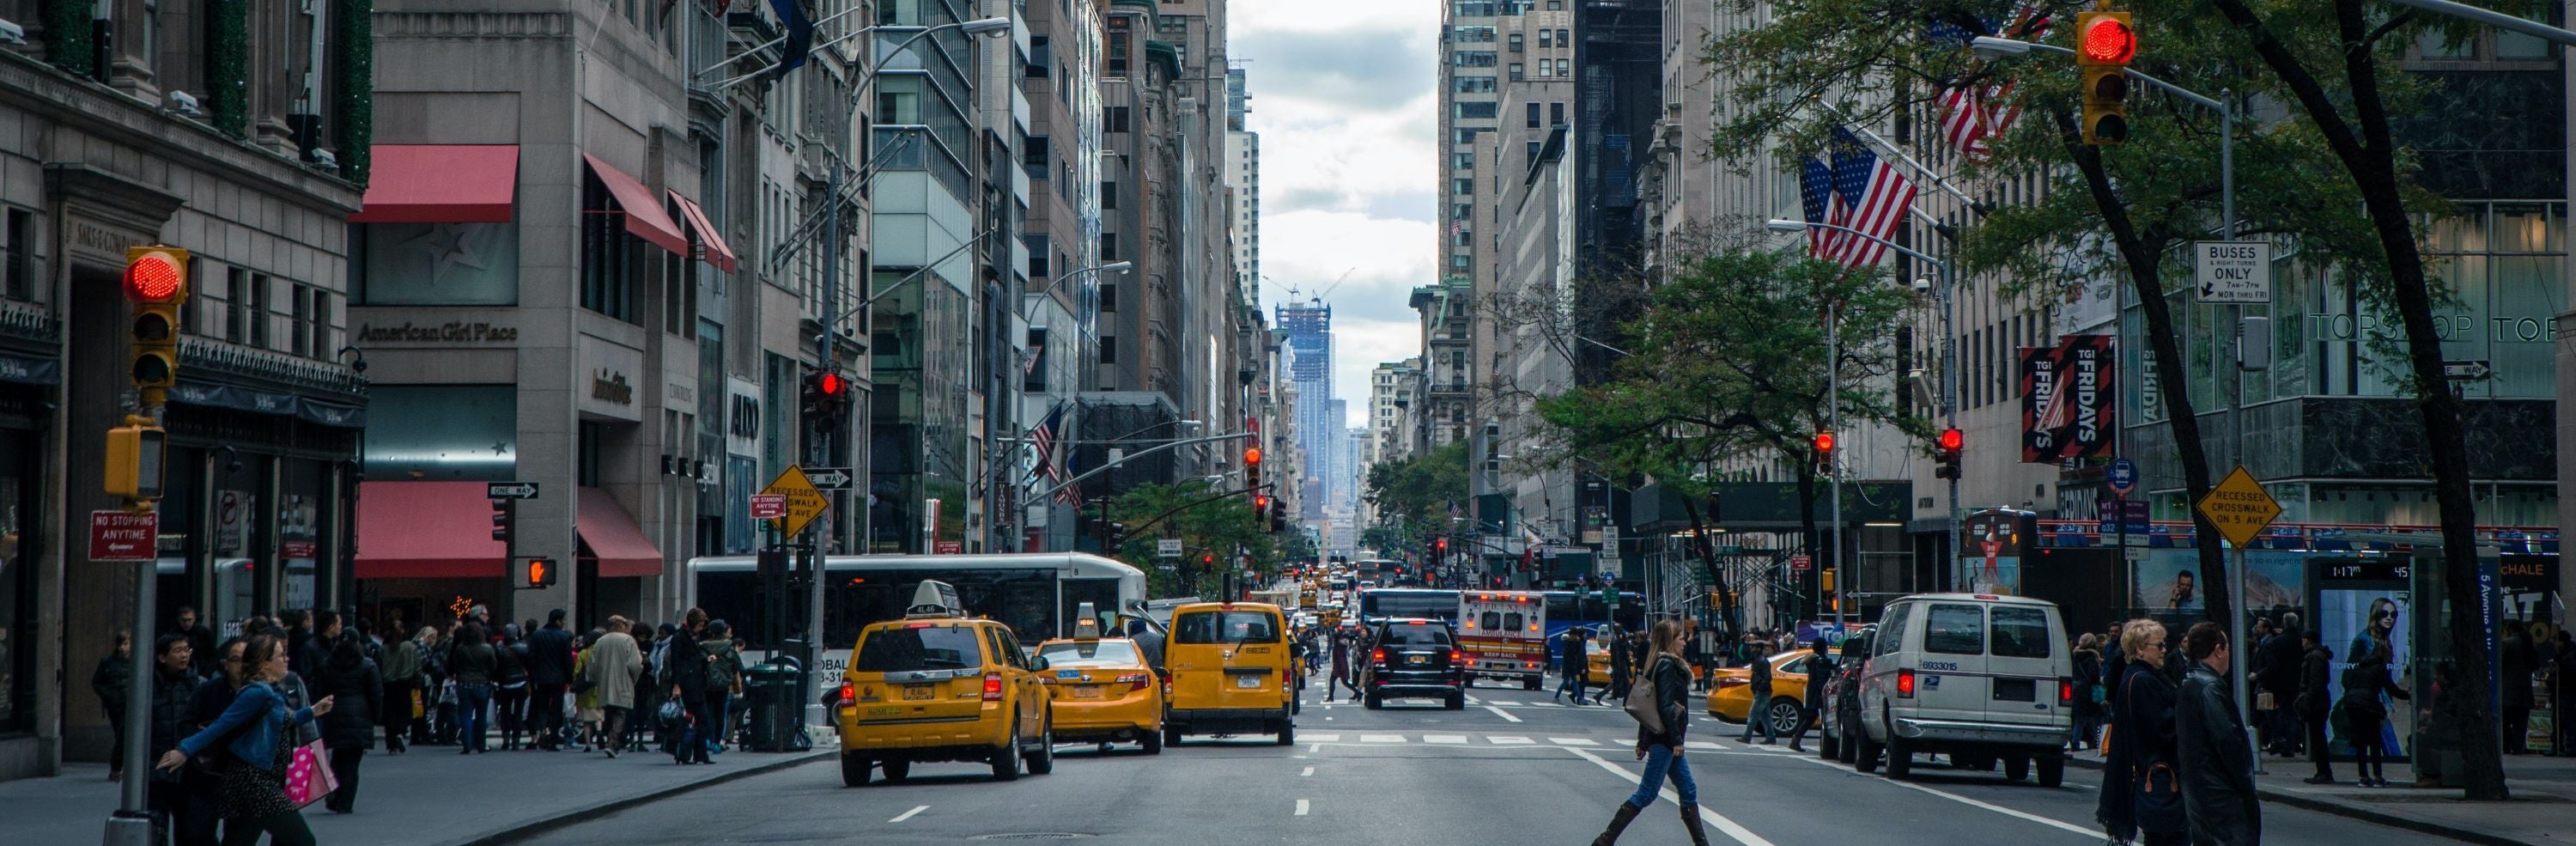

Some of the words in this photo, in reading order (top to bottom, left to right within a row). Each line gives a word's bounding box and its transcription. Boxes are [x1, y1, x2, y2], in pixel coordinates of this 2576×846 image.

[2210, 246, 2256, 259] BUSES
[2215, 268, 2251, 279] ONLY
[358, 322, 440, 342] American
[441, 321, 471, 342] Girl
[474, 322, 518, 342] Place
[2308, 313, 2473, 340] TOPSOP
[2078, 350, 2095, 359] TGI
[2035, 361, 2051, 370] TGI
[2464, 366, 2484, 375] WAY
[2078, 360, 2096, 442] FRIDAYS
[2035, 371, 2052, 448] FRIDYS
[730, 393, 759, 440] ALDO
[770, 487, 815, 496] RECESSED
[2216, 491, 2265, 502] RECESSED
[789, 499, 818, 508] SWALK
[2212, 502, 2269, 514] CROSSWALK
[795, 509, 811, 518] AVE
[95, 515, 108, 526] NO
[112, 515, 153, 526] STOPPING
[2246, 516, 2264, 525] AVE
[102, 529, 147, 540] ANYTIME
[2500, 564, 2544, 575] cHALE
[917, 605, 935, 613] 4L46
[822, 660, 848, 670] BAL
[1923, 661, 1958, 671] 6933015
